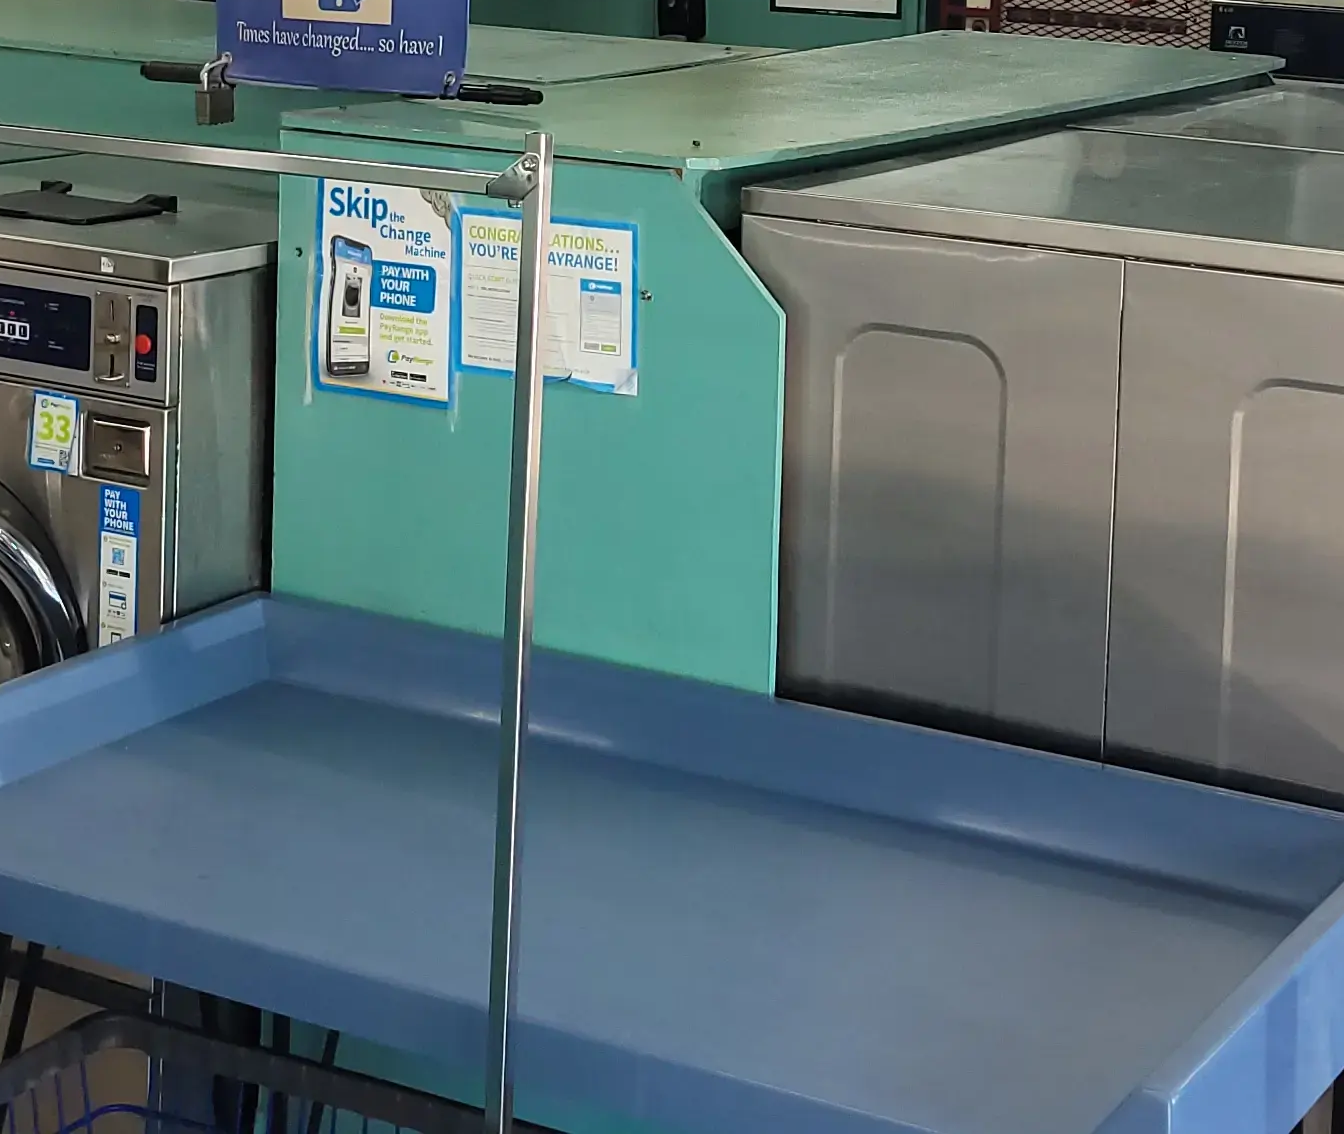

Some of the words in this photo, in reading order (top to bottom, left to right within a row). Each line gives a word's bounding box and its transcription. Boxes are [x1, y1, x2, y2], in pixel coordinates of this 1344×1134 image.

[237, 21, 269, 44] Times
[273, 21, 299, 46] have
[302, 23, 374, 57] changed....
[379, 38, 394, 52] so
[399, 29, 434, 55] have
[329, 186, 388, 228] Skip
[390, 212, 405, 223] the
[380, 224, 431, 246] Change
[469, 226, 620, 254] CONGRATIONS...
[405, 245, 446, 259] Machine
[469, 242, 518, 261] YOU'RE
[548, 251, 618, 272] AYRANGE!
[381, 265, 401, 277] PAY
[402, 267, 429, 281] WITH
[381, 278, 410, 292] YOUR
[380, 292, 416, 306] PHONE
[38, 411, 71, 443] 33
[105, 489, 120, 500] PAY
[104, 499, 126, 510] WITH
[104, 508, 127, 520] YOUR
[104, 517, 134, 531] PHONE
